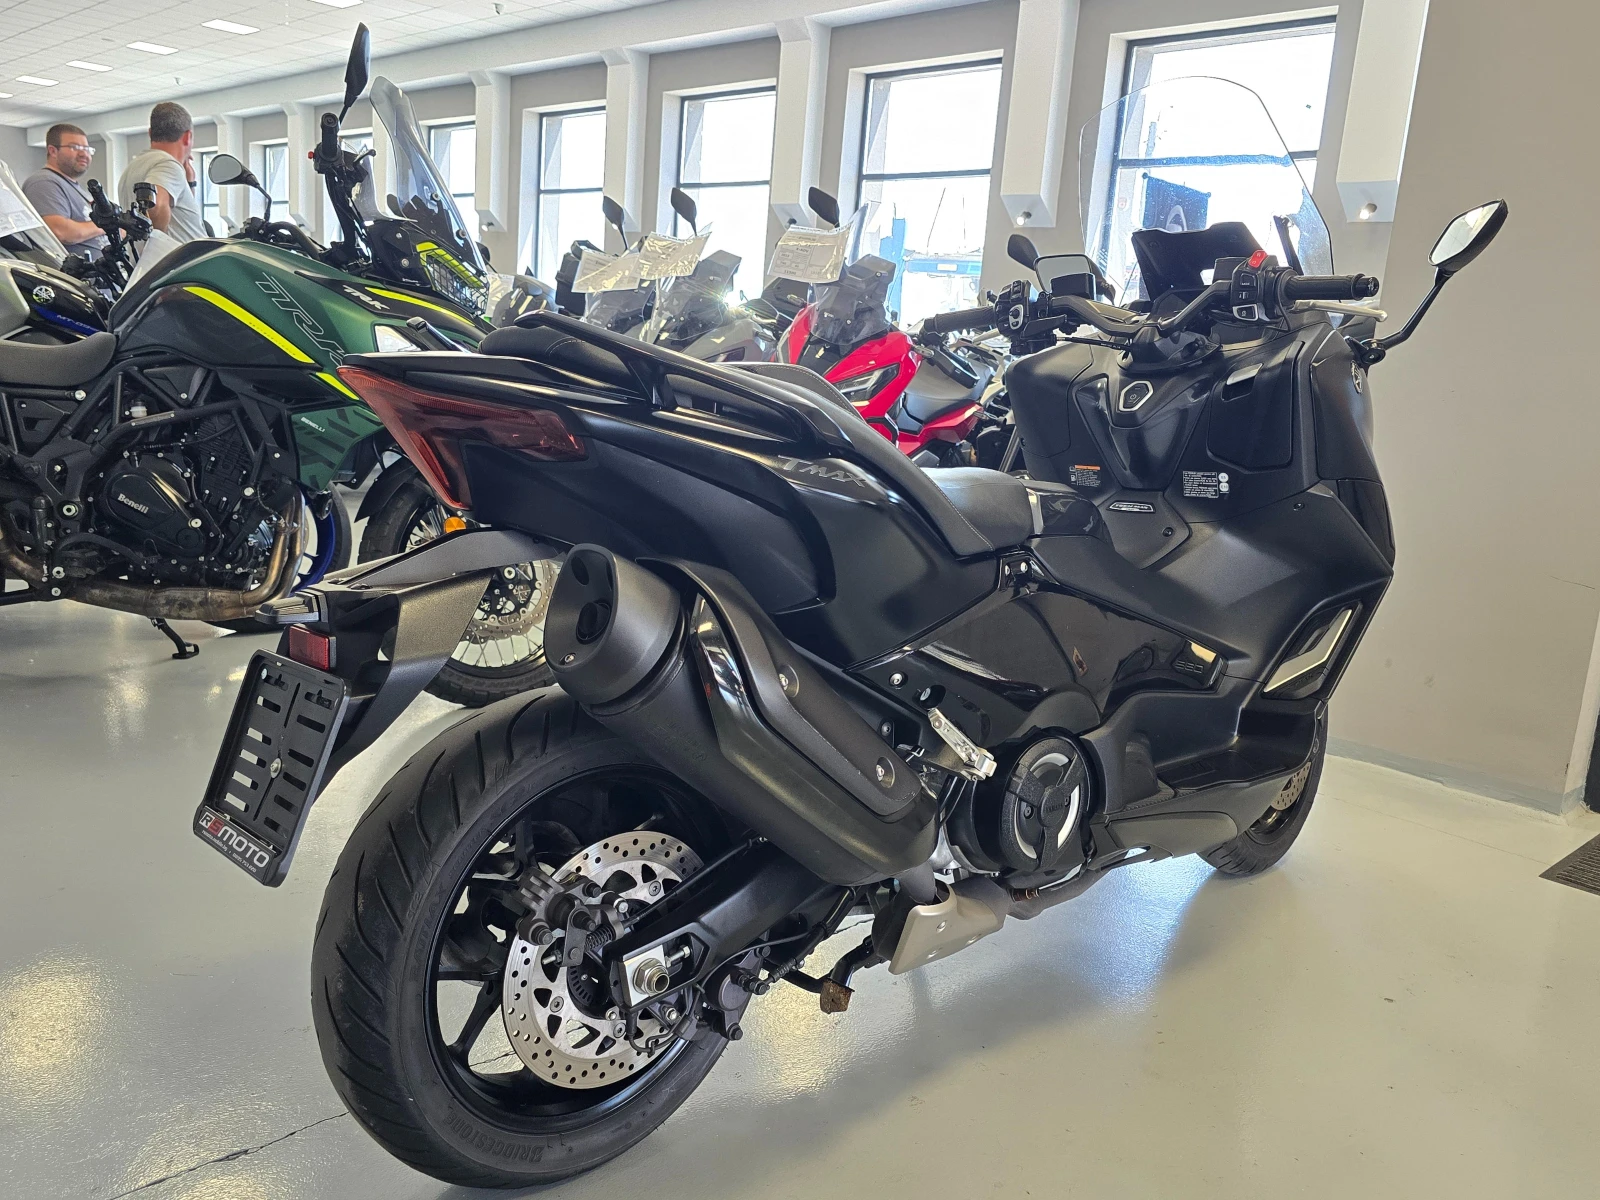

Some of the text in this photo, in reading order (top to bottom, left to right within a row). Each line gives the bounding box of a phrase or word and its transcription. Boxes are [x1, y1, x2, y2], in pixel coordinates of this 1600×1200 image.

[342, 284, 390, 310] TRK
[301, 416, 326, 432] BENELLI
[778, 455, 866, 488] TMAX
[117, 493, 149, 514] Benelli
[443, 1112, 546, 1163] BRIDGESTONE
